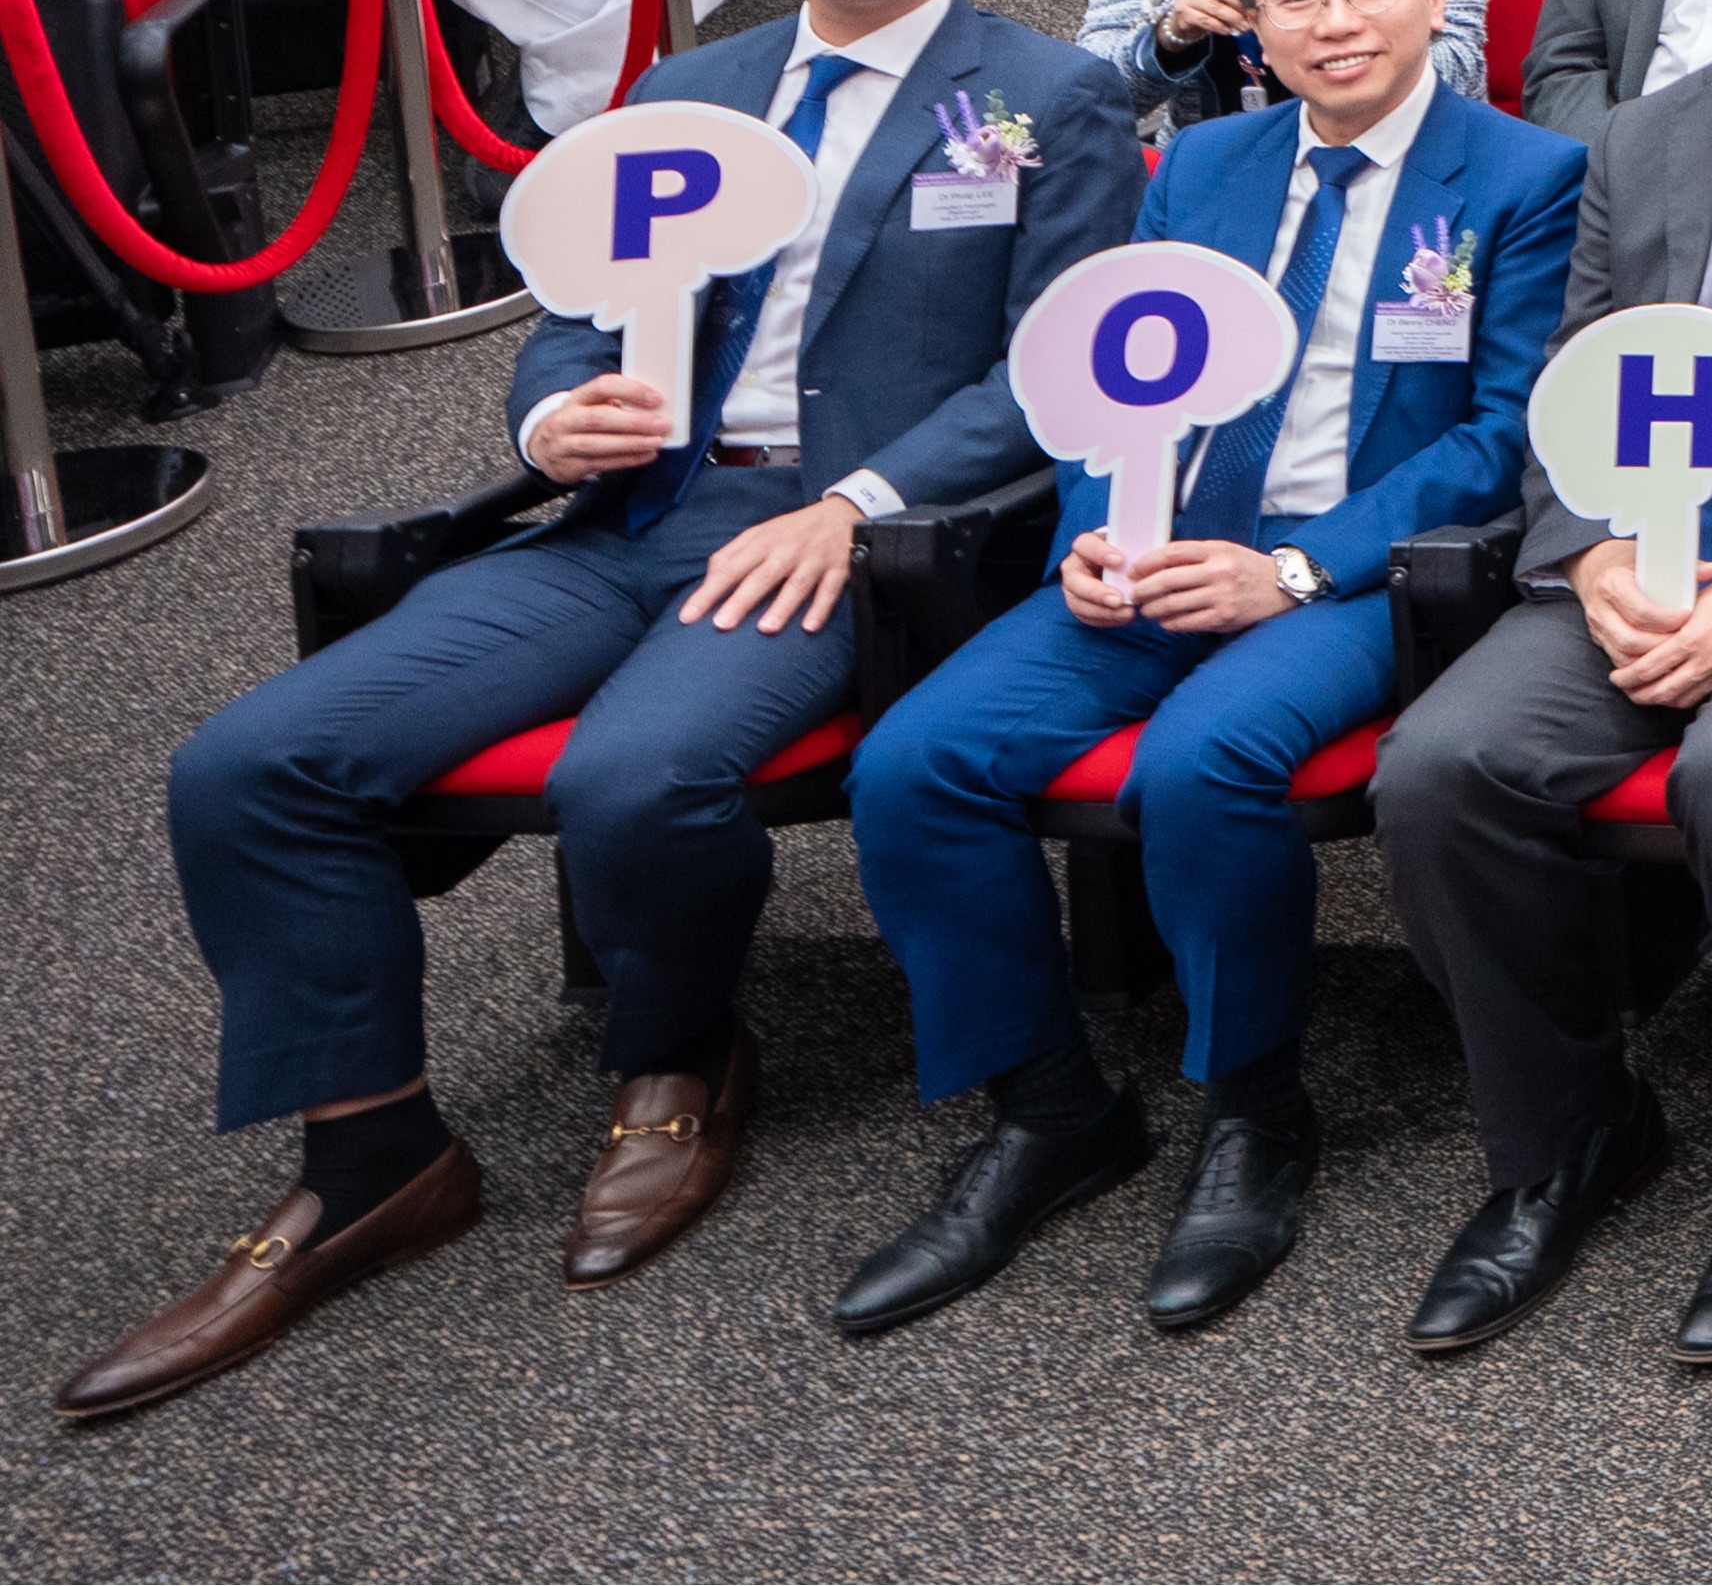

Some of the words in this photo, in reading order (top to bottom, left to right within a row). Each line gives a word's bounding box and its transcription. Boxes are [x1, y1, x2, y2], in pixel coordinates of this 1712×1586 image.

[612, 149, 721, 260] P
[1092, 290, 1209, 406] O
[1387, 318, 1396, 326] Dr
